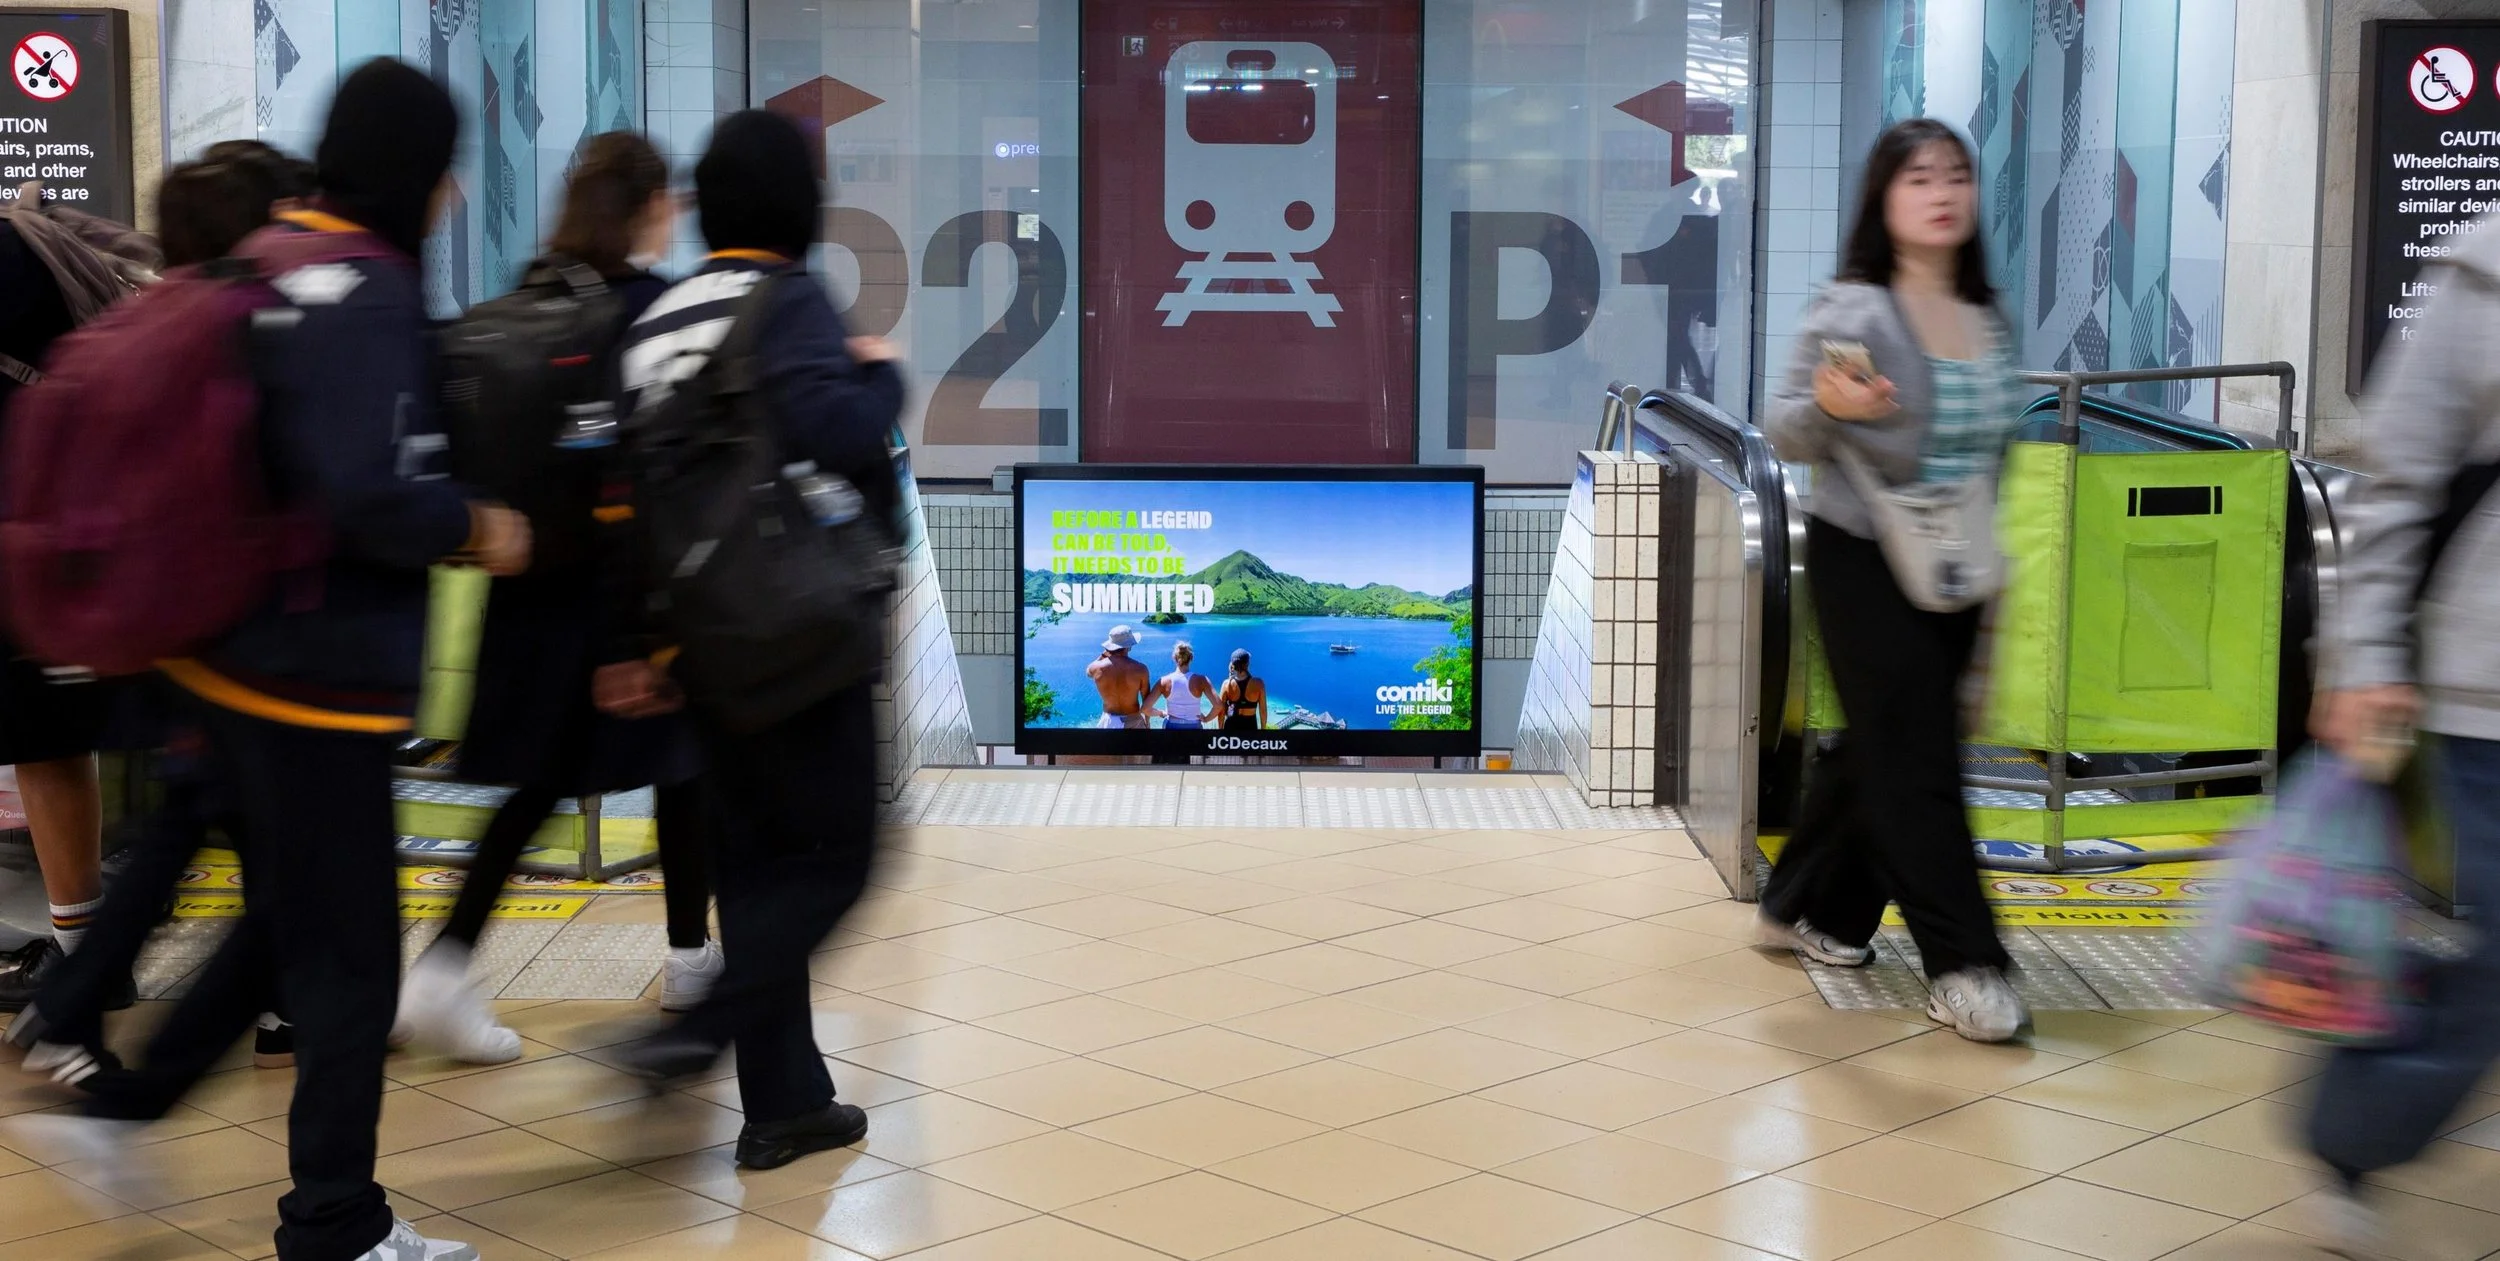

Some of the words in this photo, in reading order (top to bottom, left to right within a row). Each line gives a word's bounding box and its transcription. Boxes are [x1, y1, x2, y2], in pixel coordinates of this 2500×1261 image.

[0, 118, 48, 133] TION
[2440, 131, 2500, 146] CAUTI
[36, 143, 94, 159] prams,
[4, 162, 37, 178] and
[41, 162, 87, 178] other
[2401, 176, 2471, 191] strollers
[0, 185, 57, 200] eves
[61, 188, 89, 200] are
[2398, 198, 2456, 213] similar
[2403, 243, 2451, 257] these
[2401, 282, 2439, 297] Lifts
[2388, 304, 2428, 319] loca
[1447, 211, 1719, 450] P1
[1052, 510, 1122, 529] BEFORE
[1125, 511, 1138, 529] A
[1141, 511, 1212, 529] LEGEND
[1052, 533, 1089, 551] CAN
[1093, 533, 1117, 551] BE
[1120, 533, 1172, 553] TOLD,
[1052, 556, 1069, 574] IT
[1073, 556, 1132, 574] NEEDS
[1136, 556, 1159, 574] TO
[1162, 556, 1186, 575] BE
[1052, 582, 1215, 614] SUMMITED
[1376, 678, 1453, 702] contiki
[1376, 704, 1396, 715] LIVE
[1398, 704, 1415, 715] THE
[1417, 704, 1452, 715] LEGEND
[1208, 736, 1288, 750] JCDecaux
[399, 903, 562, 912] Harail
[2036, 911, 2128, 921] Hold
